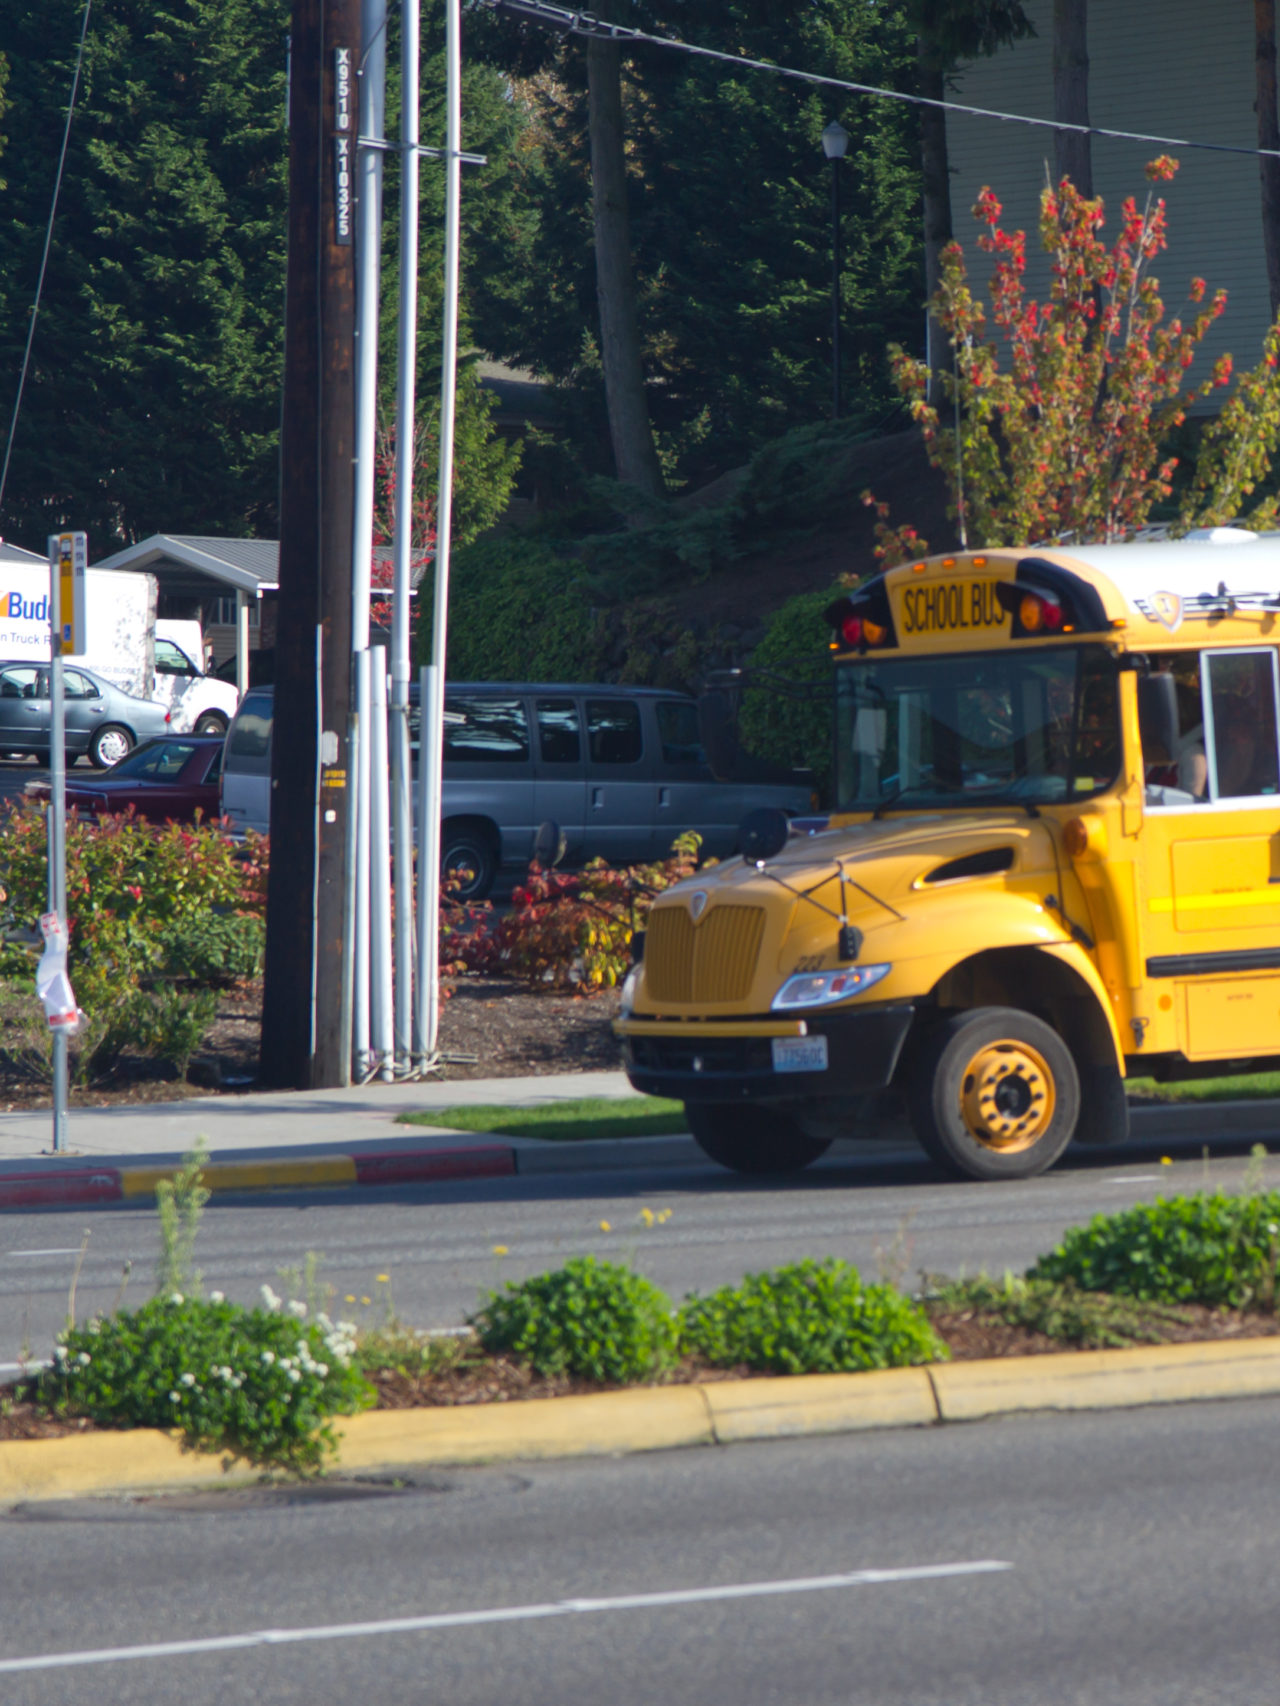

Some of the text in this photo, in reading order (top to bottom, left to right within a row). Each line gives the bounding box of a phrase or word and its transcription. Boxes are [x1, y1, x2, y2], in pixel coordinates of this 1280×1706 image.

[338, 48, 350, 130] X9510
[338, 138, 350, 236] X10325
[904, 581, 1006, 633] SCHOOL BUS
[10, 631, 40, 645] Truck
[793, 953, 826, 973] 223
